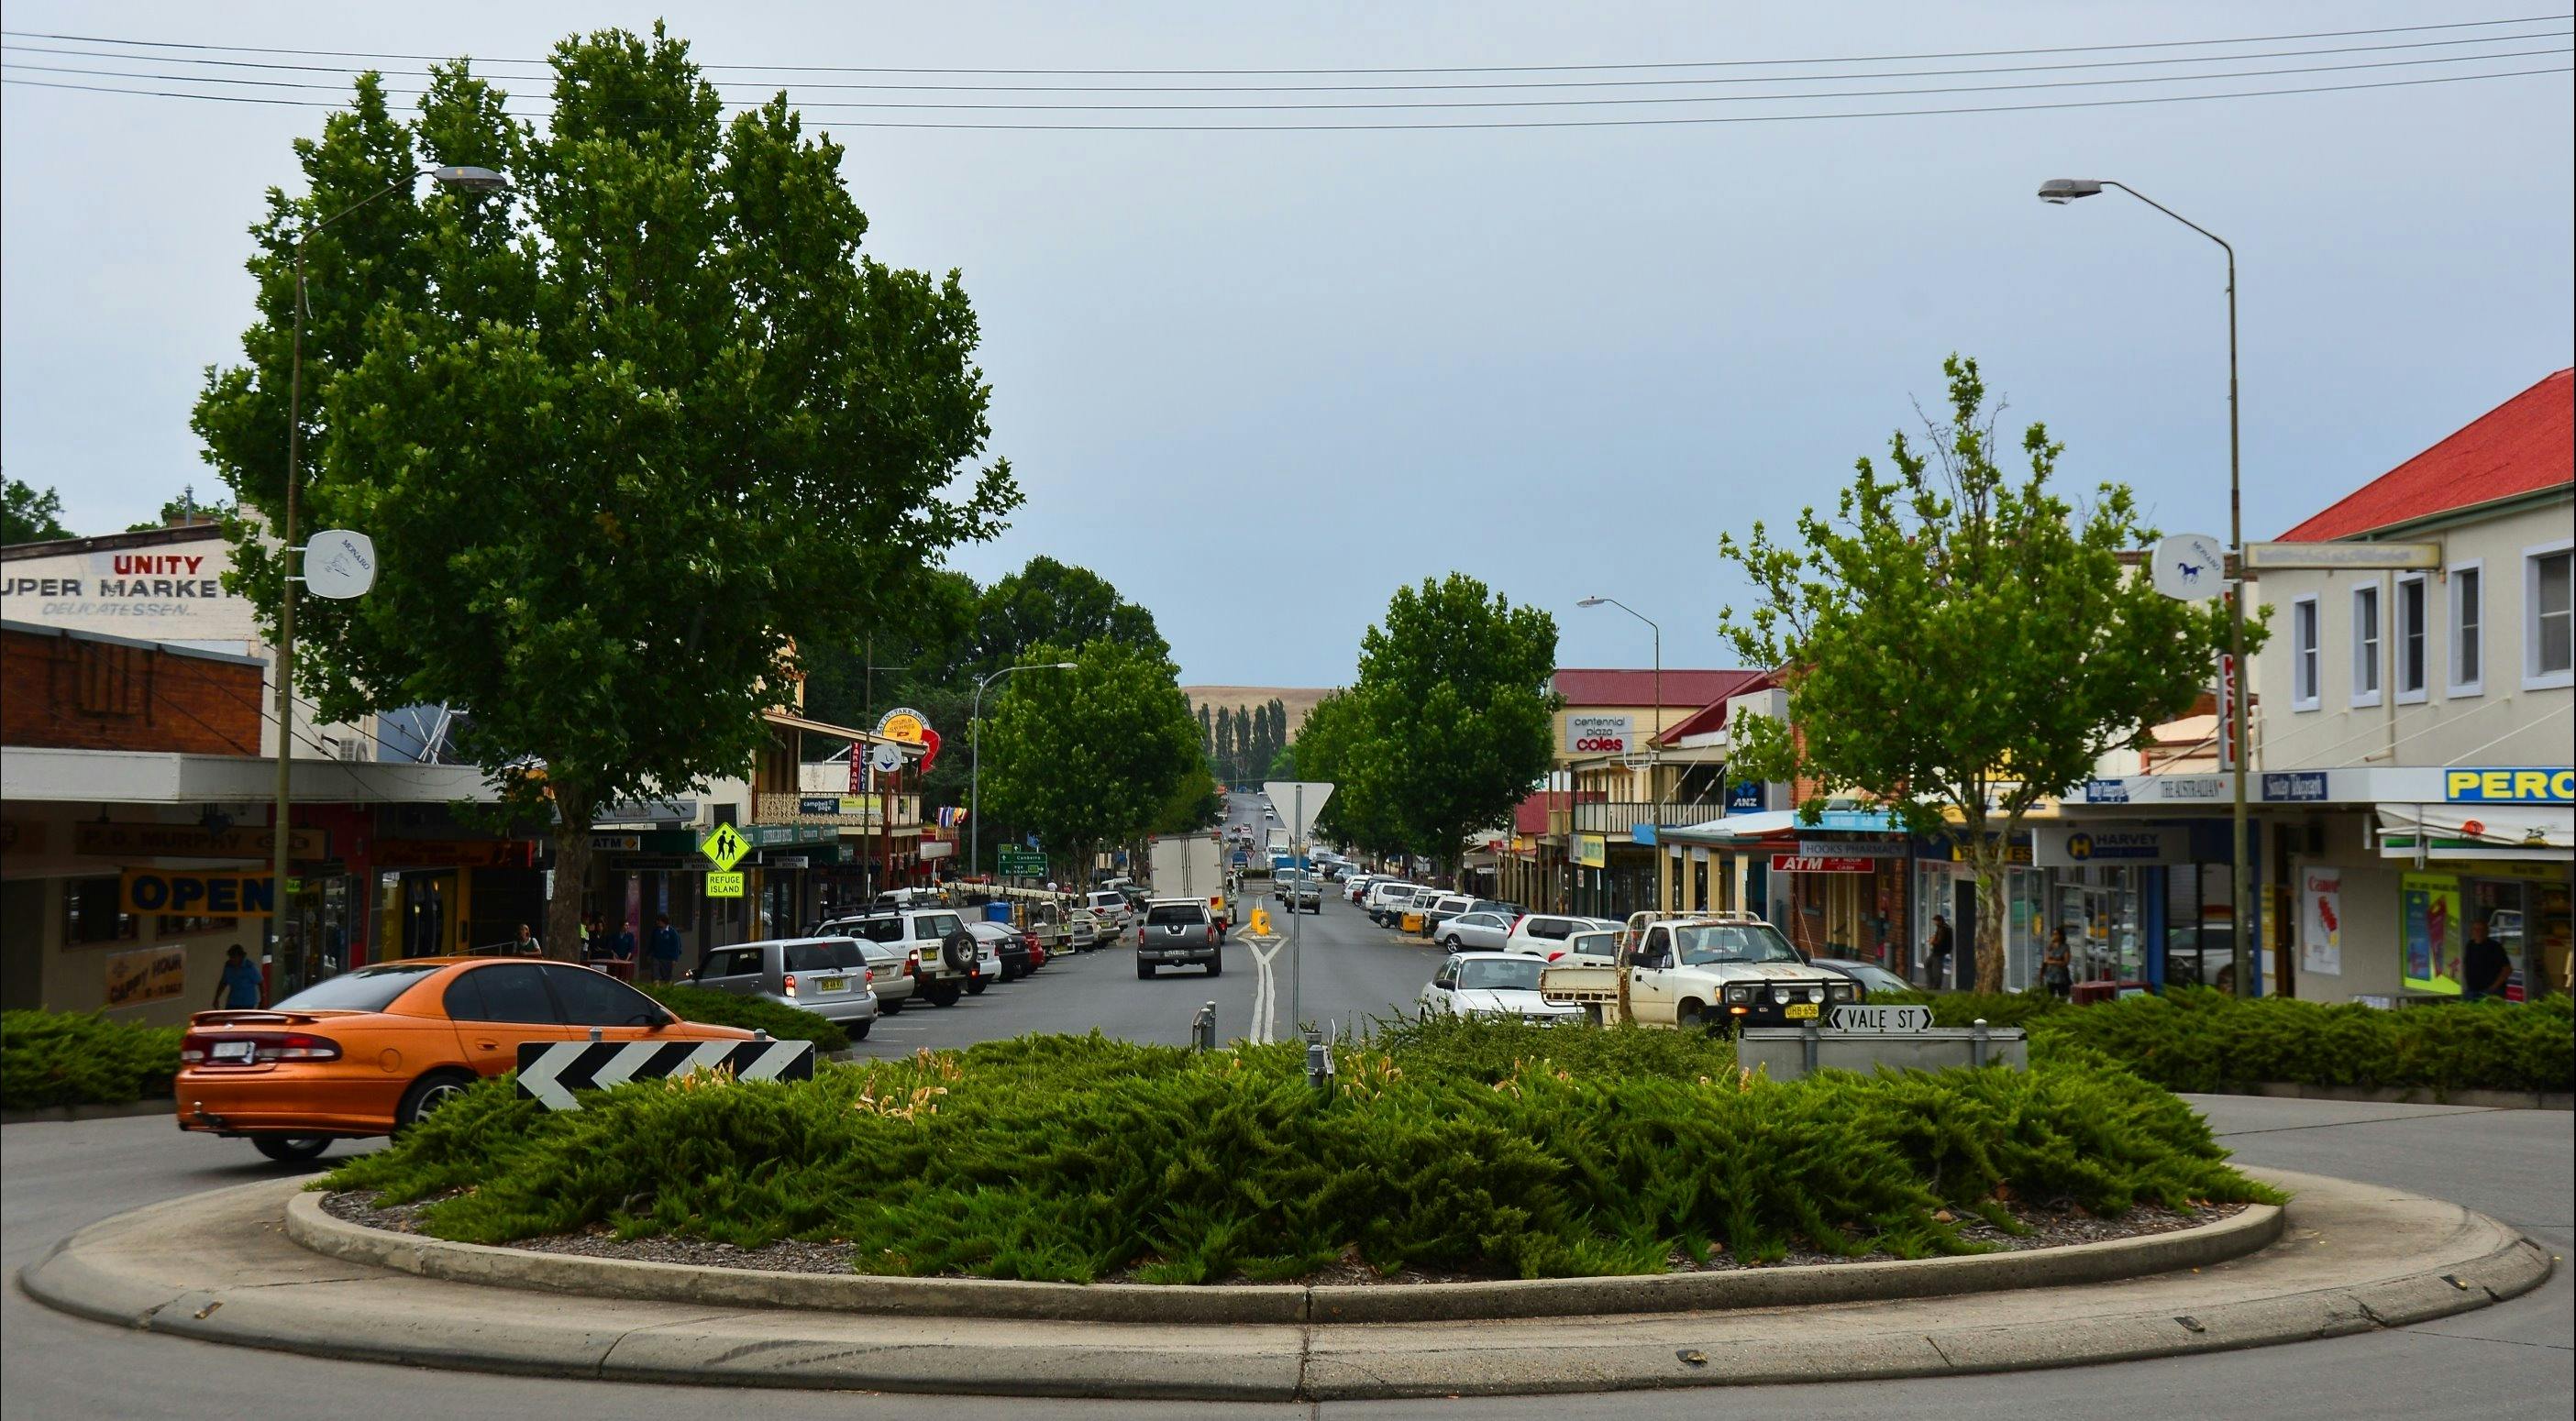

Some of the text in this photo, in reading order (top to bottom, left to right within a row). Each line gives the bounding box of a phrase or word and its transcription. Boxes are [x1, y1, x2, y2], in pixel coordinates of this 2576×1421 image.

[341, 539, 370, 570] MONARO
[2191, 540, 2222, 572] MONARO
[114, 555, 204, 575] UNITY
[101, 578, 235, 598] MARKE
[912, 711, 928, 726] AWAY
[1575, 716, 1626, 726] centennial
[1587, 726, 1613, 737] plaza
[1576, 736, 1623, 751] coles
[851, 742, 859, 768] TAKE
[2161, 779, 2220, 798] THE AUSTRALIAN
[803, 799, 829, 809] campbell
[817, 805, 833, 813] page
[1733, 798, 1758, 807] ANZ
[139, 831, 242, 850] MURPHY
[591, 838, 622, 848] ATM
[2095, 833, 2159, 845] HARVEY
[1806, 844, 1902, 854] HOOKS PHARMACY
[2071, 838, 2090, 857] H
[1782, 857, 1824, 870] ATM
[710, 876, 740, 884] REFUGE
[131, 875, 274, 912] OPEN
[710, 885, 740, 894] ISLAND
[1847, 1009, 1915, 1028] VALE ST
